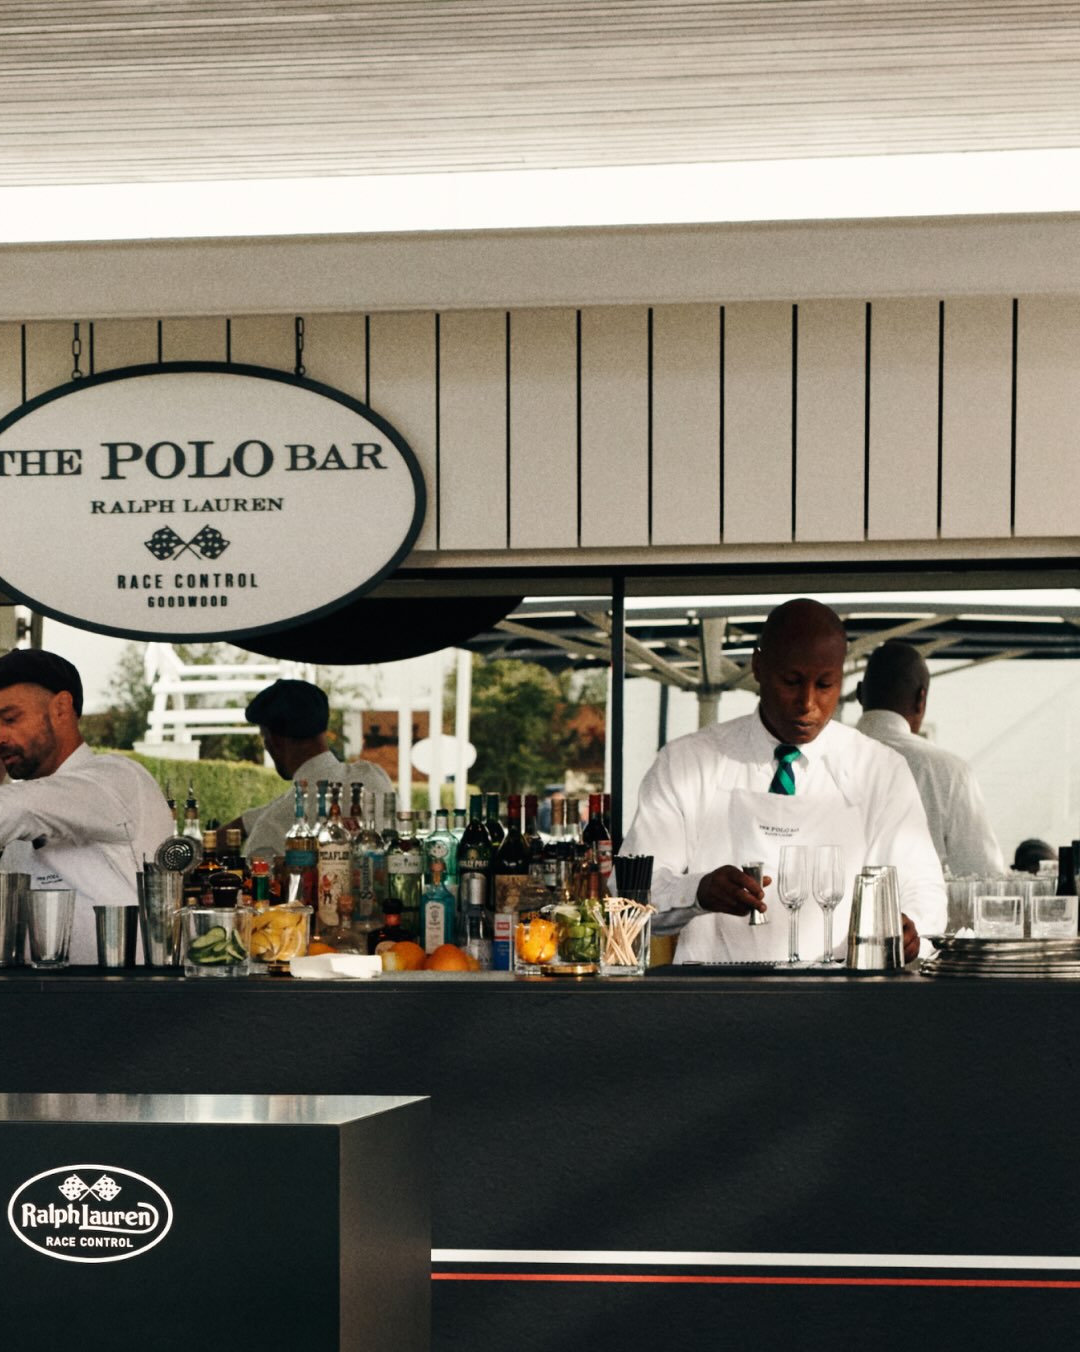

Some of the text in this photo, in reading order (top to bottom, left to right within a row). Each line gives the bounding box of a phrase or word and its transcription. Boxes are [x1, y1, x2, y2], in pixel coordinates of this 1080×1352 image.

[100, 439, 275, 481] POLO
[284, 442, 388, 472] BAR
[90, 497, 285, 515] RALPH LAUREN
[117, 572, 259, 590] RACE CONTROL
[147, 595, 229, 608] GOODWOOD
[21, 1201, 159, 1235] Ralph Lauren
[46, 1236, 134, 1248] RACE CONTROL
